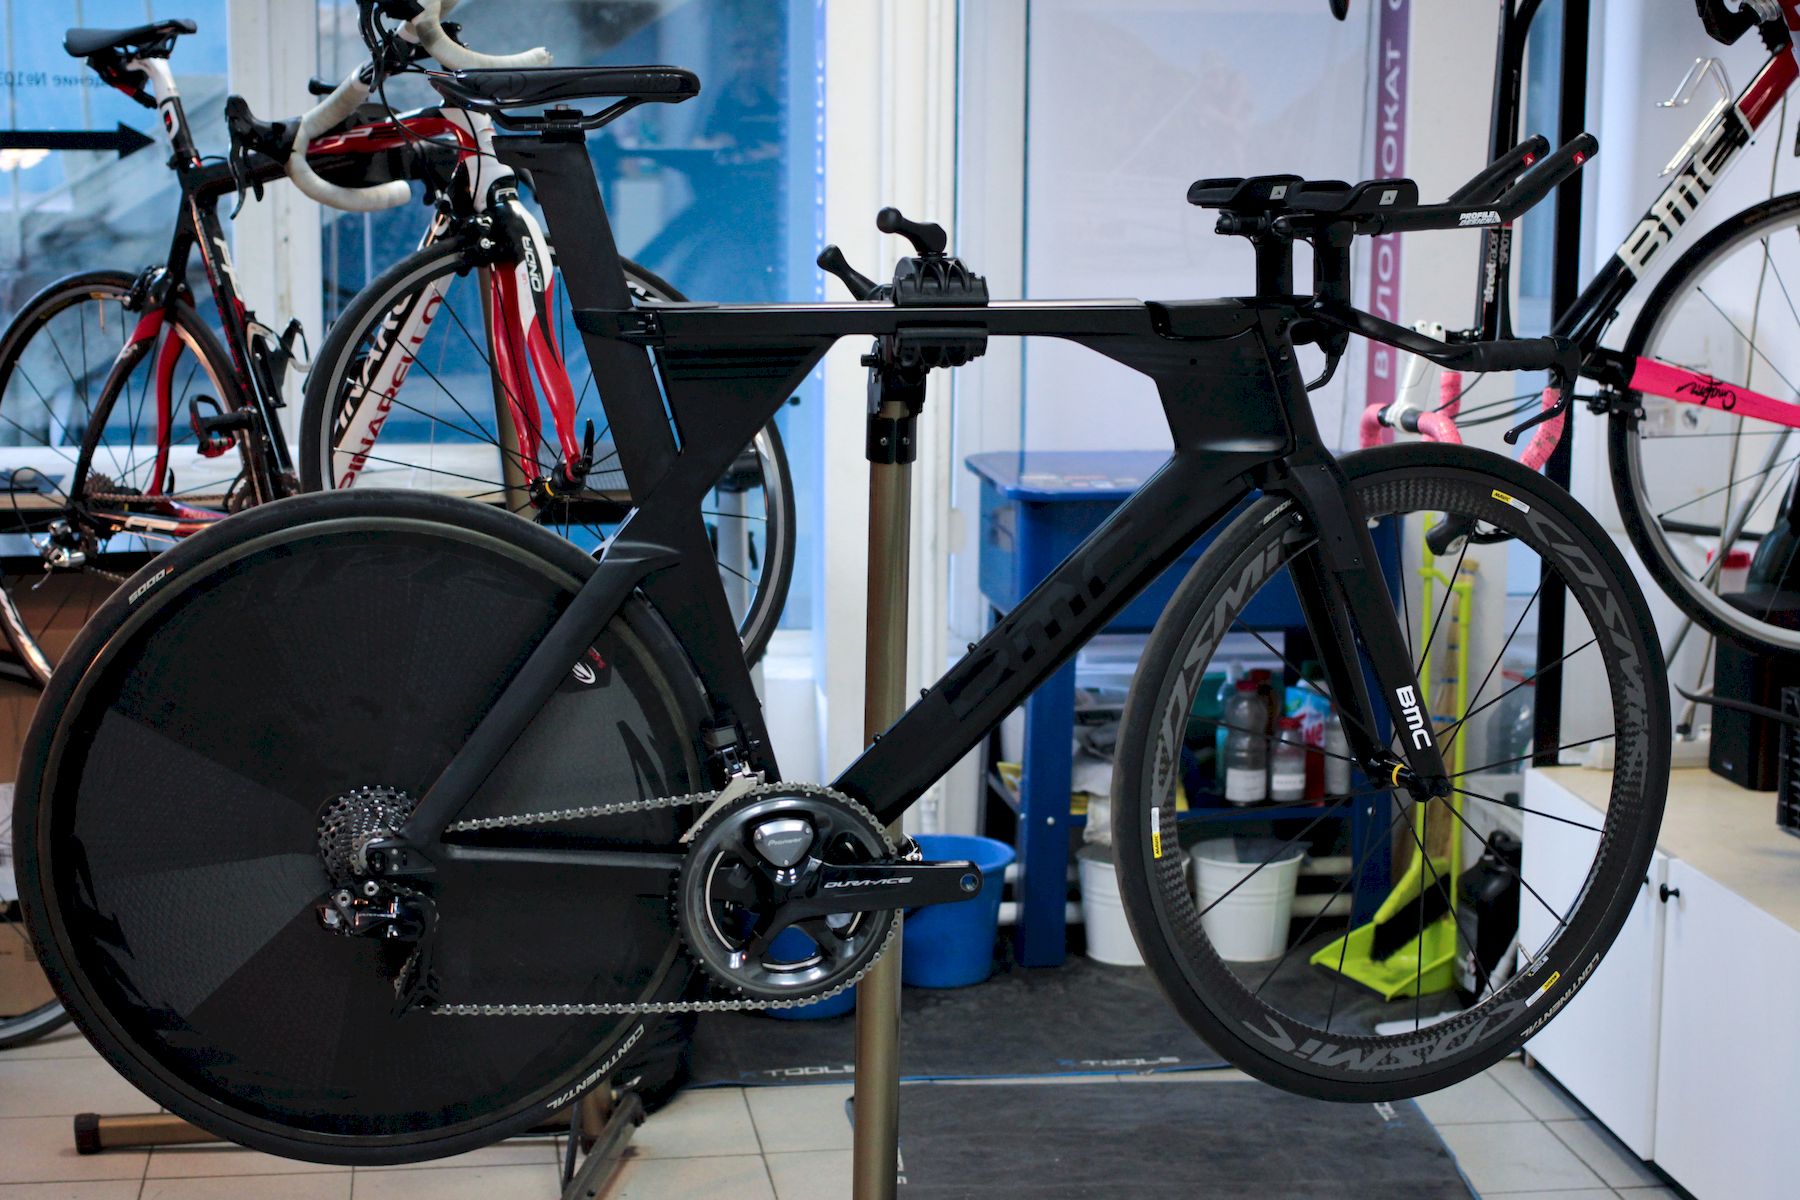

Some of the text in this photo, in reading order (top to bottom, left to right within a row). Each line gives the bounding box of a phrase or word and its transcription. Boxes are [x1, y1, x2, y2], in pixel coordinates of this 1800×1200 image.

[1374, 38, 1402, 379] ВЛООКАТ
[1460, 211, 1495, 221] PROFILE
[1616, 118, 1742, 281] BMC
[521, 235, 542, 292] ONDA
[338, 295, 442, 489] PINARELLO
[1395, 684, 1433, 751] BMC
[767, 837, 803, 847] Pioneer
[823, 876, 914, 889] DURA-ACE
[1520, 951, 1600, 1038] CONTINENTAL
[546, 1023, 645, 1110] CONTINENTAL
